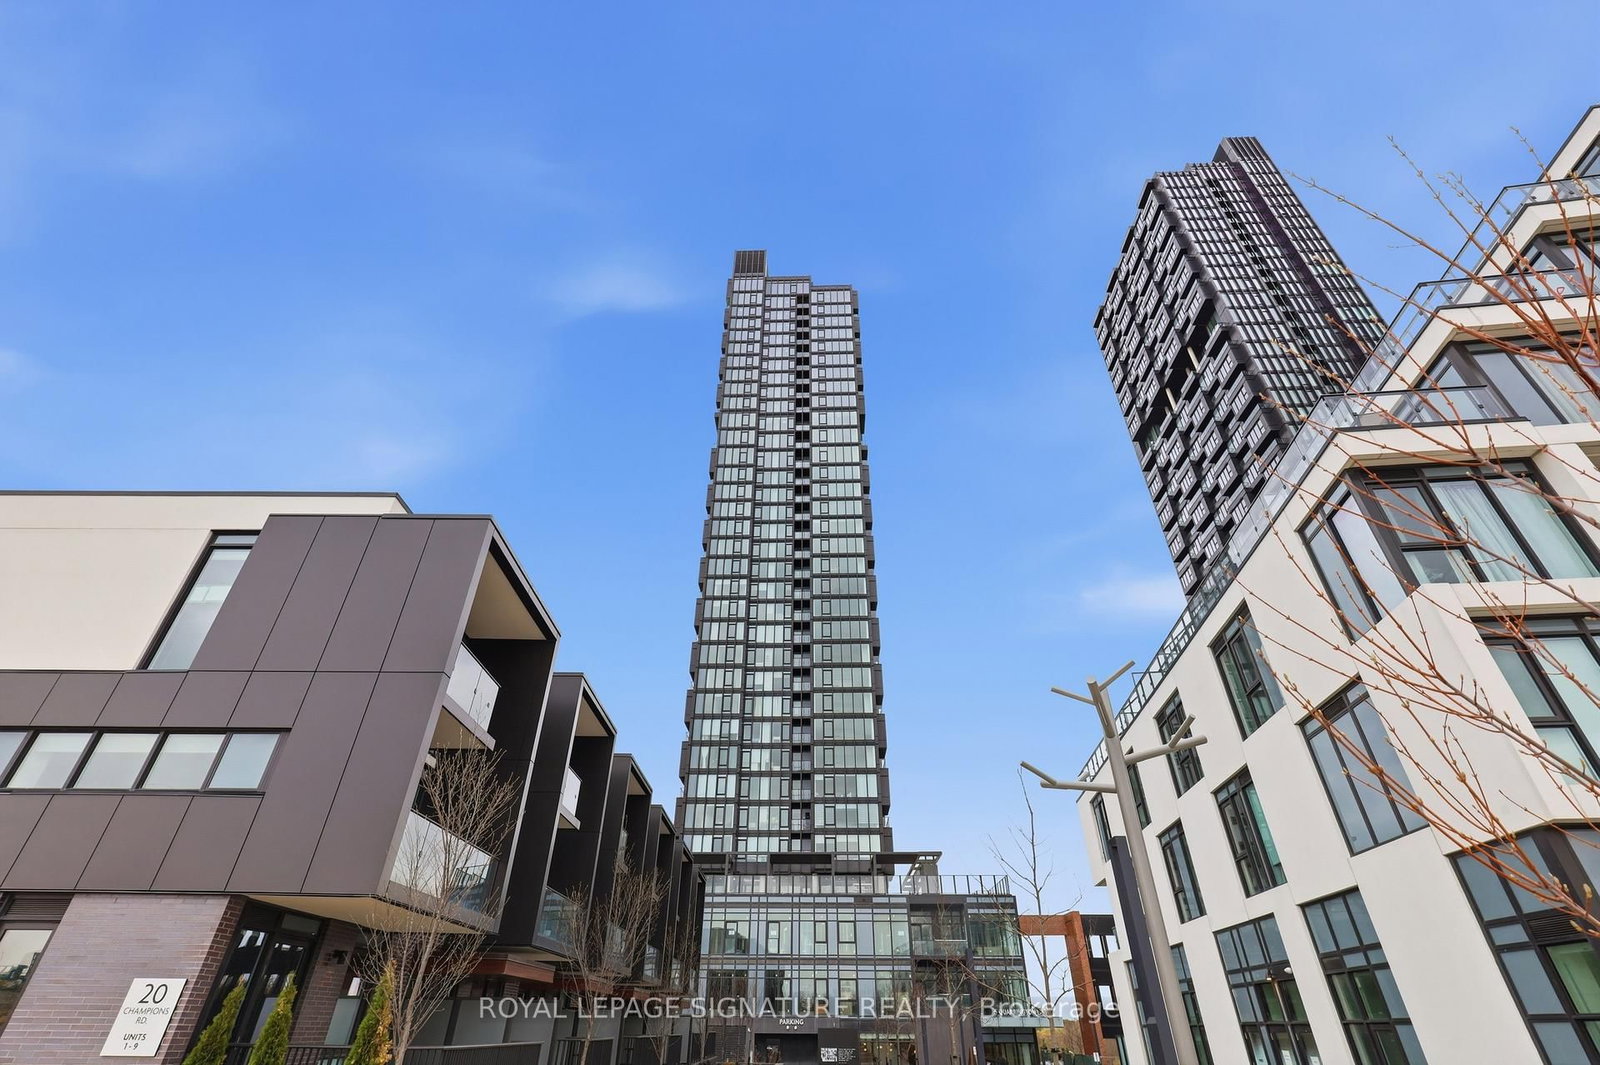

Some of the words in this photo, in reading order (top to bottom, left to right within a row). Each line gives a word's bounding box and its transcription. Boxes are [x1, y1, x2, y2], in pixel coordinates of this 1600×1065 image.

[138, 983, 168, 1004] 20
[123, 1007, 170, 1015] CHAMPIONS
[135, 1016, 147, 1024] RD.
[123, 1033, 147, 1041] UNITS
